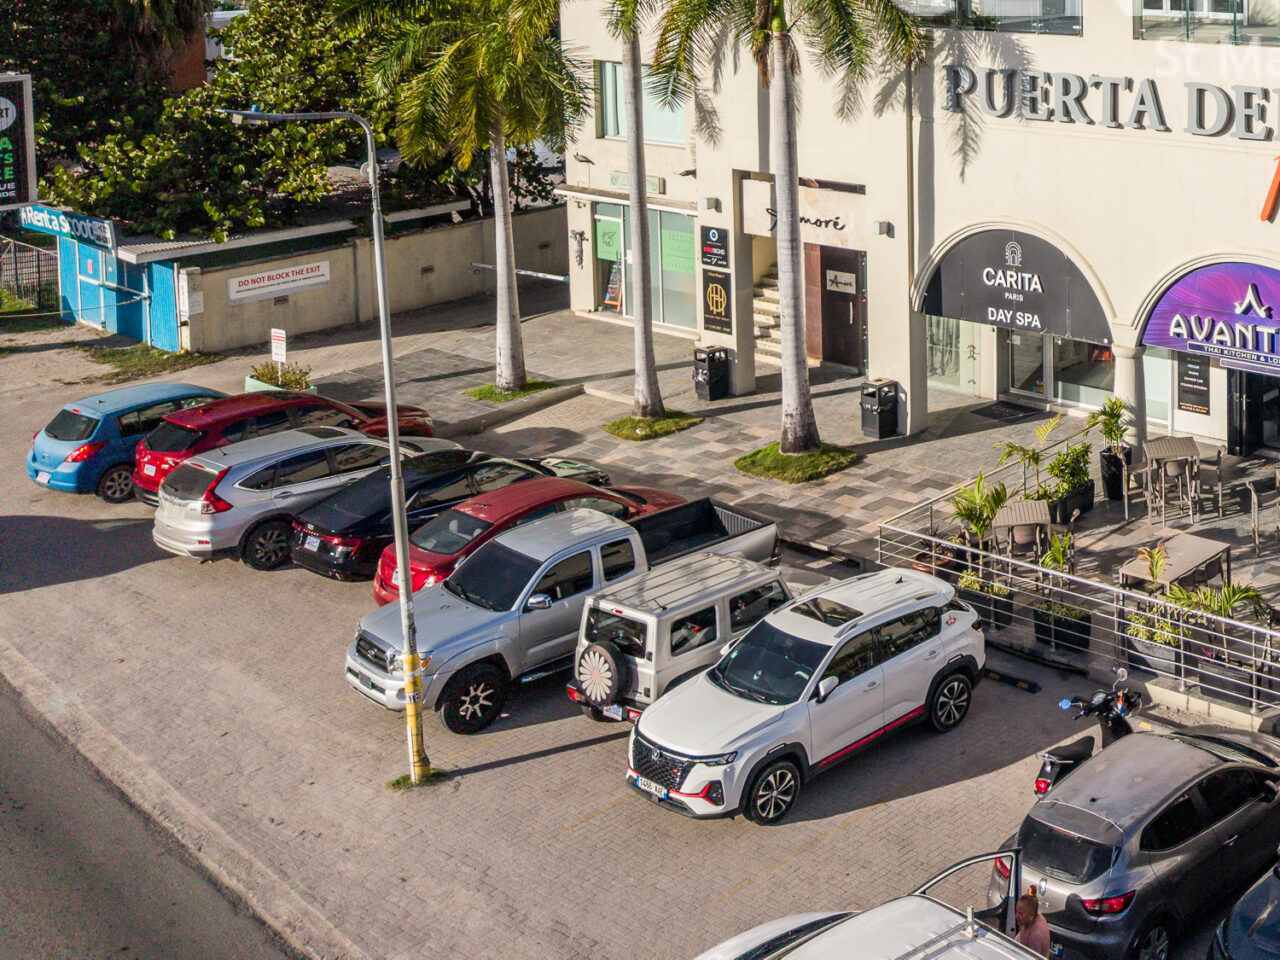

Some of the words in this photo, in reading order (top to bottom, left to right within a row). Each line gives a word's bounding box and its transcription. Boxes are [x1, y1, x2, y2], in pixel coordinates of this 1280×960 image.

[943, 64, 1173, 132] PUERTA
[238, 279, 249, 288] DO
[250, 277, 265, 286] NOT
[267, 271, 290, 281] BLOCK
[291, 269, 304, 277] THE
[306, 265, 320, 274] EXIT
[983, 267, 1044, 293] CARITA
[1004, 292, 1024, 302] PARIS
[988, 307, 1013, 324] DAY
[1015, 311, 1041, 329] SPA
[1203, 345, 1221, 353] THAI
[1223, 348, 1257, 361] KITCHEN
